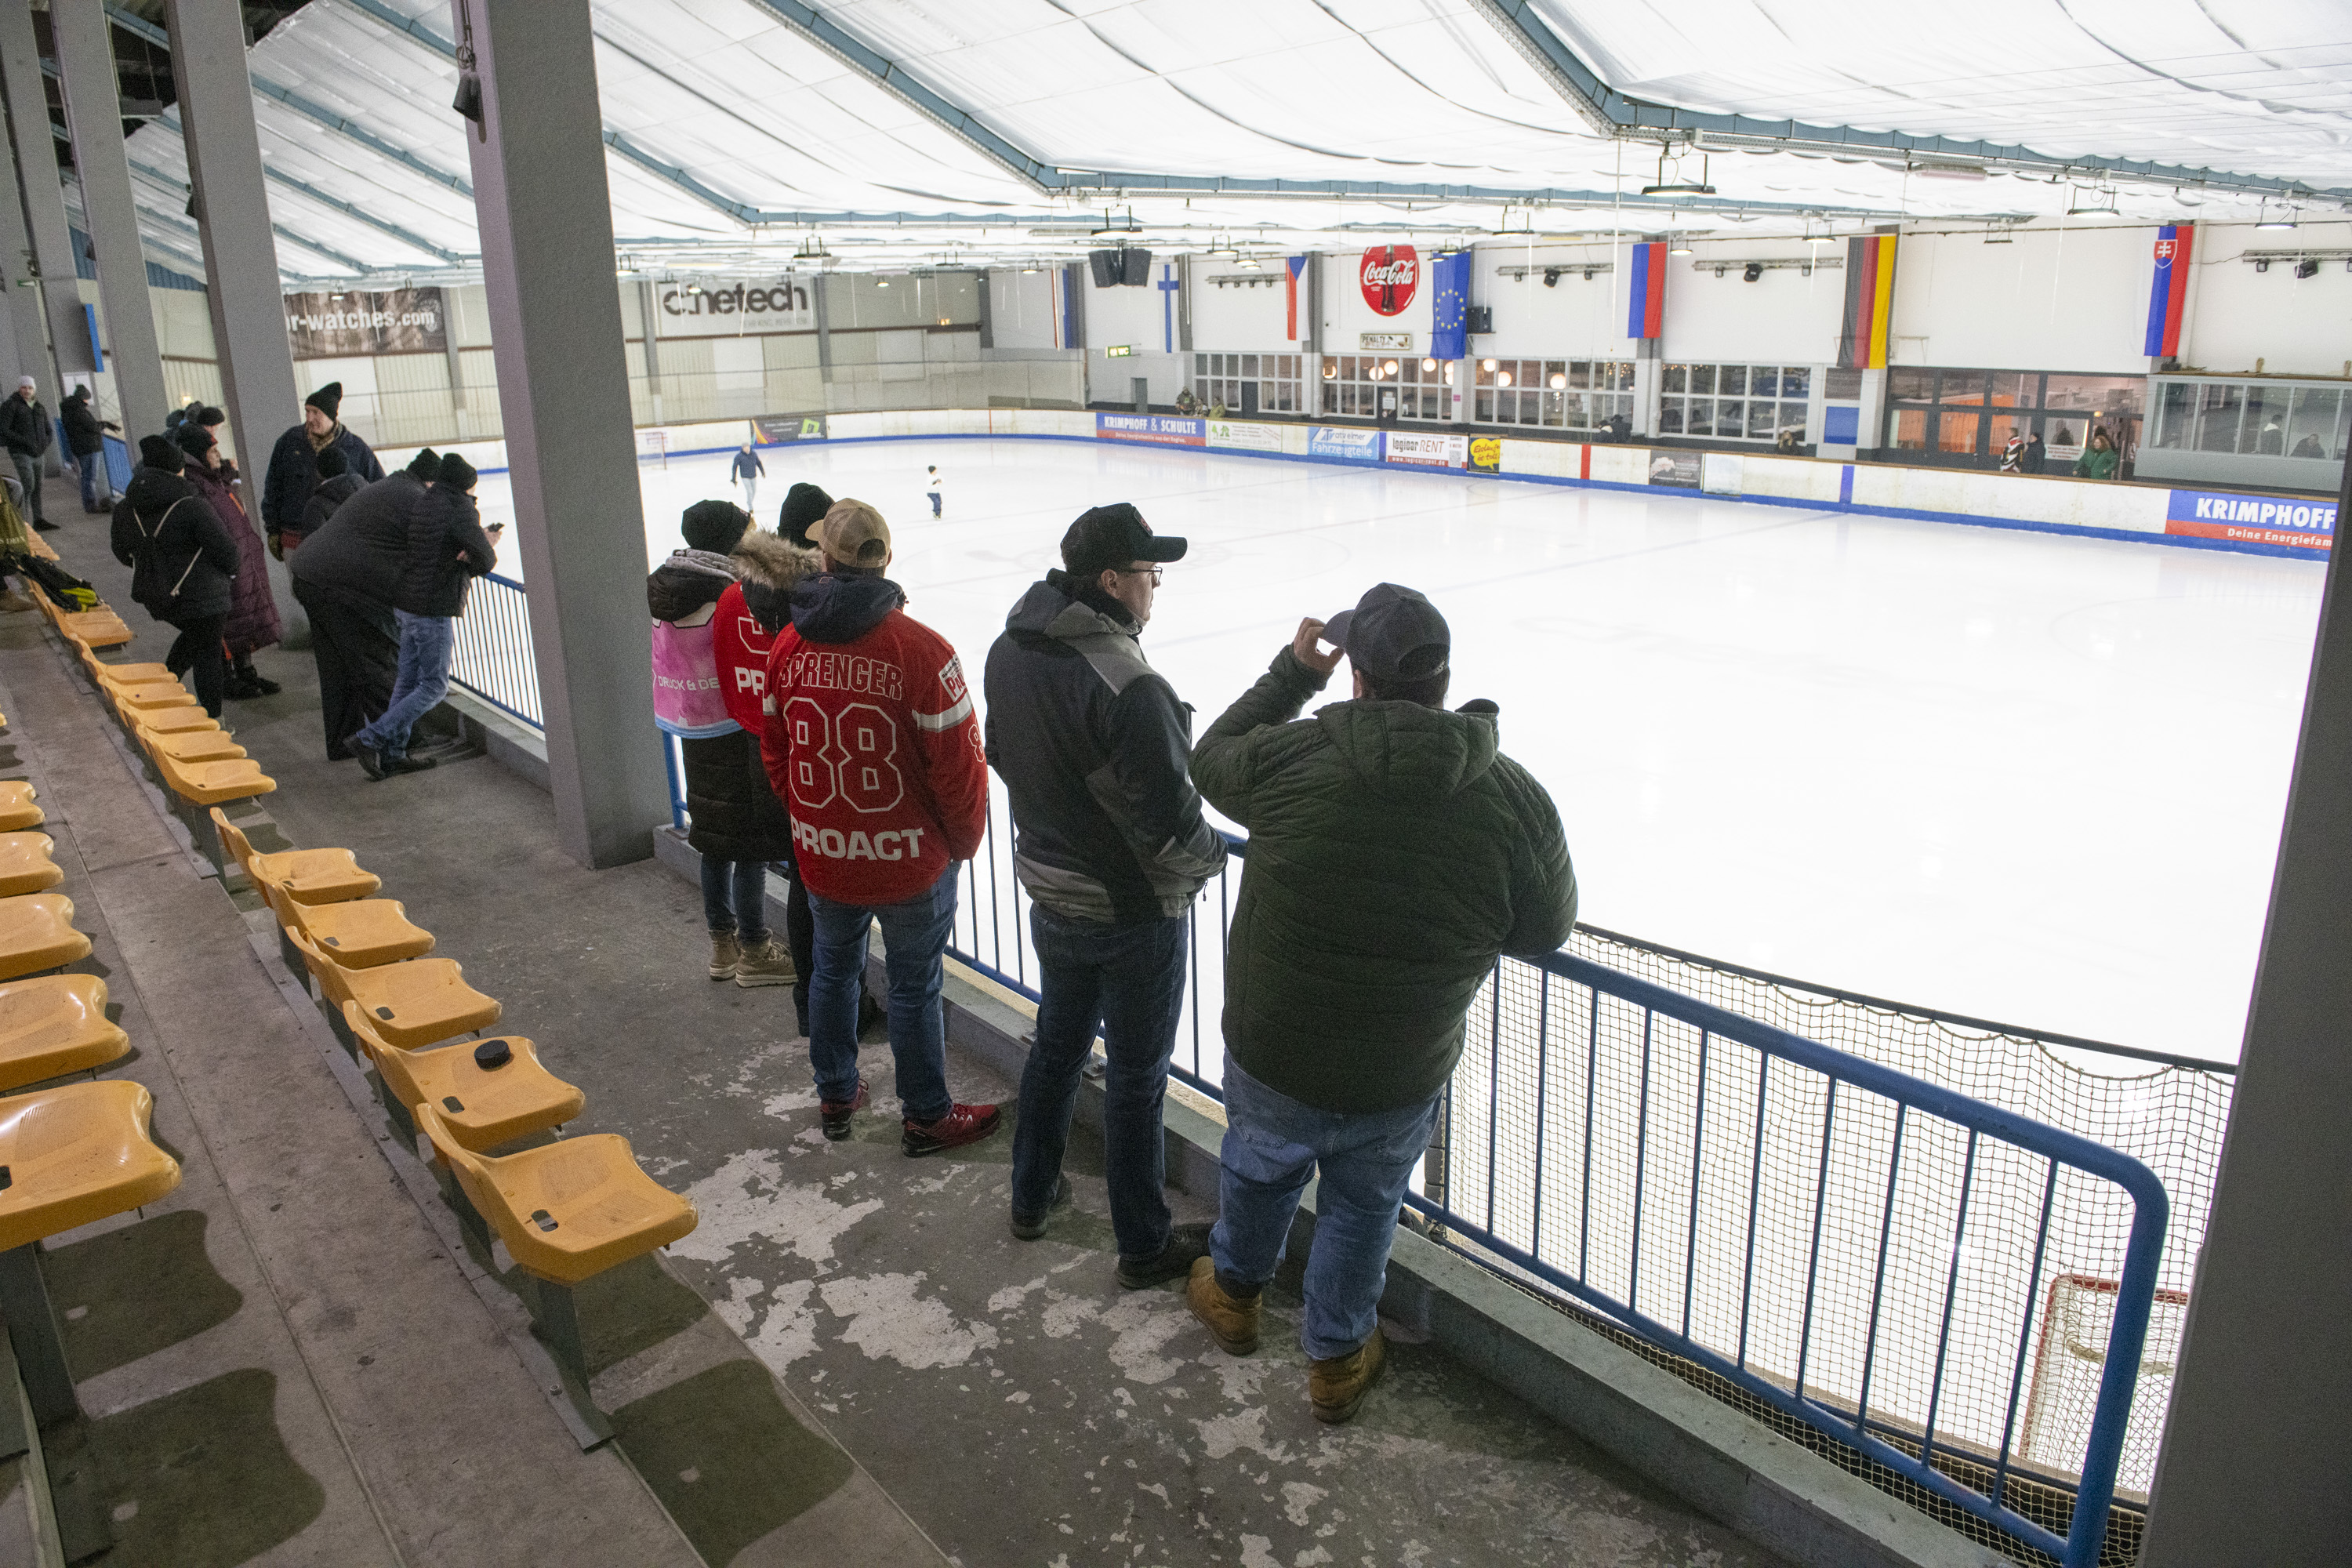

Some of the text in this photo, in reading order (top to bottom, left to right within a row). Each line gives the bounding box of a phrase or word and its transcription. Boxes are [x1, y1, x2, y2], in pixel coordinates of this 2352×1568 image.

[1363, 260, 1416, 286] Coca-Cola
[1117, 347, 1130, 356] WC
[1104, 416, 1196, 435] KRIMPHOFF & SCHULTE
[1312, 442, 1373, 458] Fahrzeugteile
[1419, 440, 1445, 453] RENT
[2196, 497, 2336, 530] KRIMPHOFF
[2227, 528, 2332, 546] Deine Energiefam
[658, 676, 685, 691] DRUCK
[687, 680, 696, 691] &
[780, 652, 903, 701] SPRENGER
[784, 696, 904, 813] 88
[790, 813, 924, 862] PROACT
